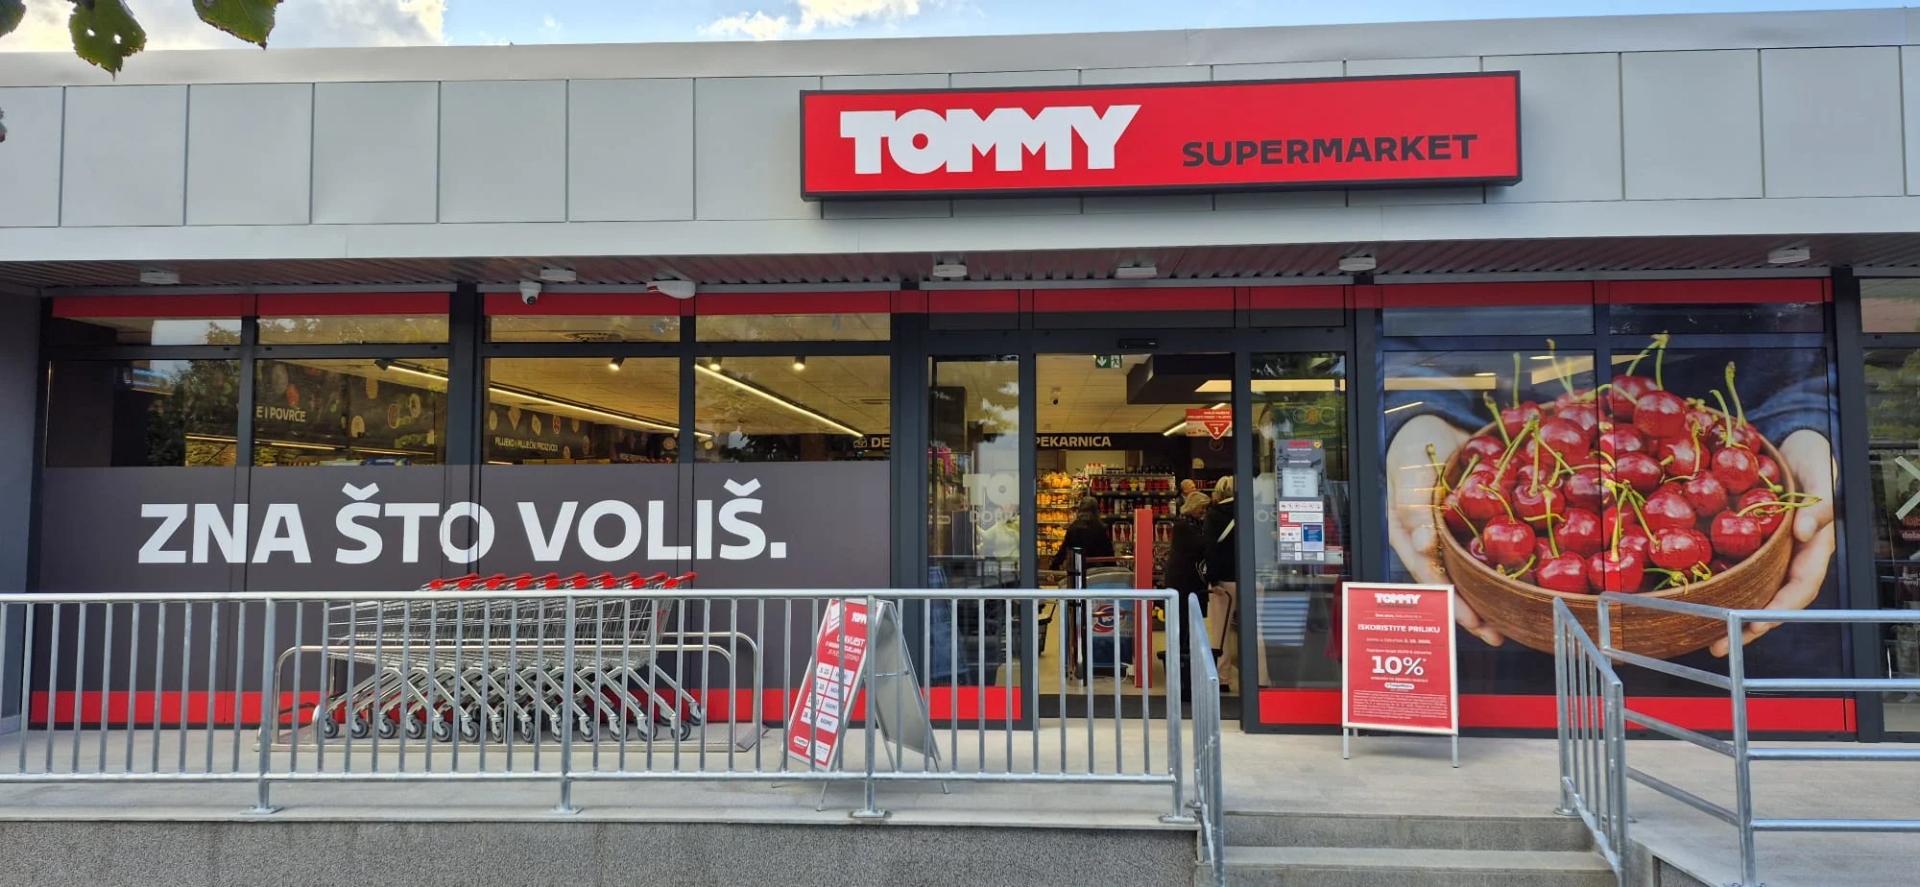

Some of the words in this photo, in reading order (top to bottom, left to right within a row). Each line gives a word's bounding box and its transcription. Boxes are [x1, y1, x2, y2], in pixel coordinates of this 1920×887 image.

[840, 104, 1141, 175] TOMMY
[1182, 133, 1478, 168] SUPERMARKET
[138, 503, 312, 563] ZNA
[335, 482, 496, 564] ŠTO
[517, 478, 787, 562] VOLIŠ.
[1374, 593, 1421, 605] TOMMY
[1357, 623, 1407, 632] ISKORISTITE
[1408, 625, 1440, 634] PRILIKU
